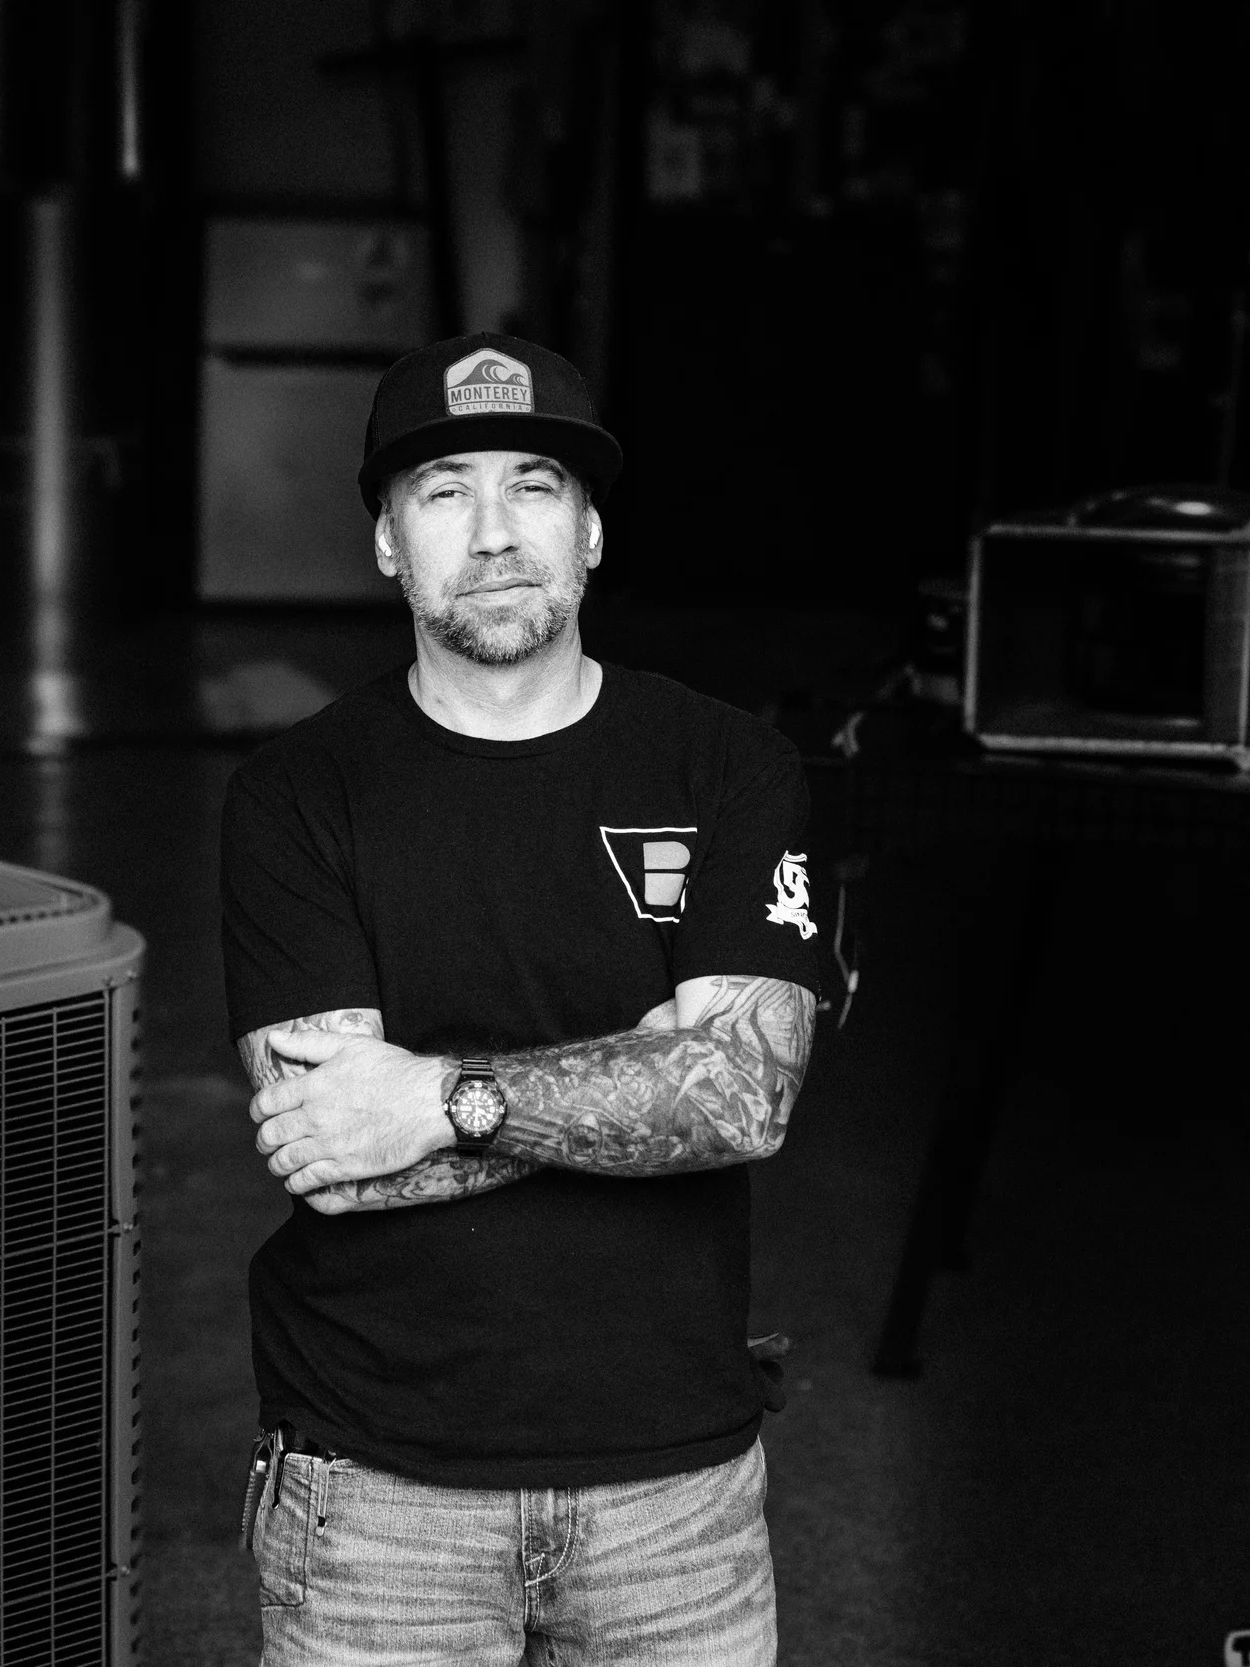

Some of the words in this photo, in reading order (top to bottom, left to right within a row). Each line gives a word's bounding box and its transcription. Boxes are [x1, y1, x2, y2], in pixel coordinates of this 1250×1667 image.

[450, 386, 527, 403] MONTEREY
[458, 402, 523, 412] CALIFORNIA
[642, 841, 691, 907] B
